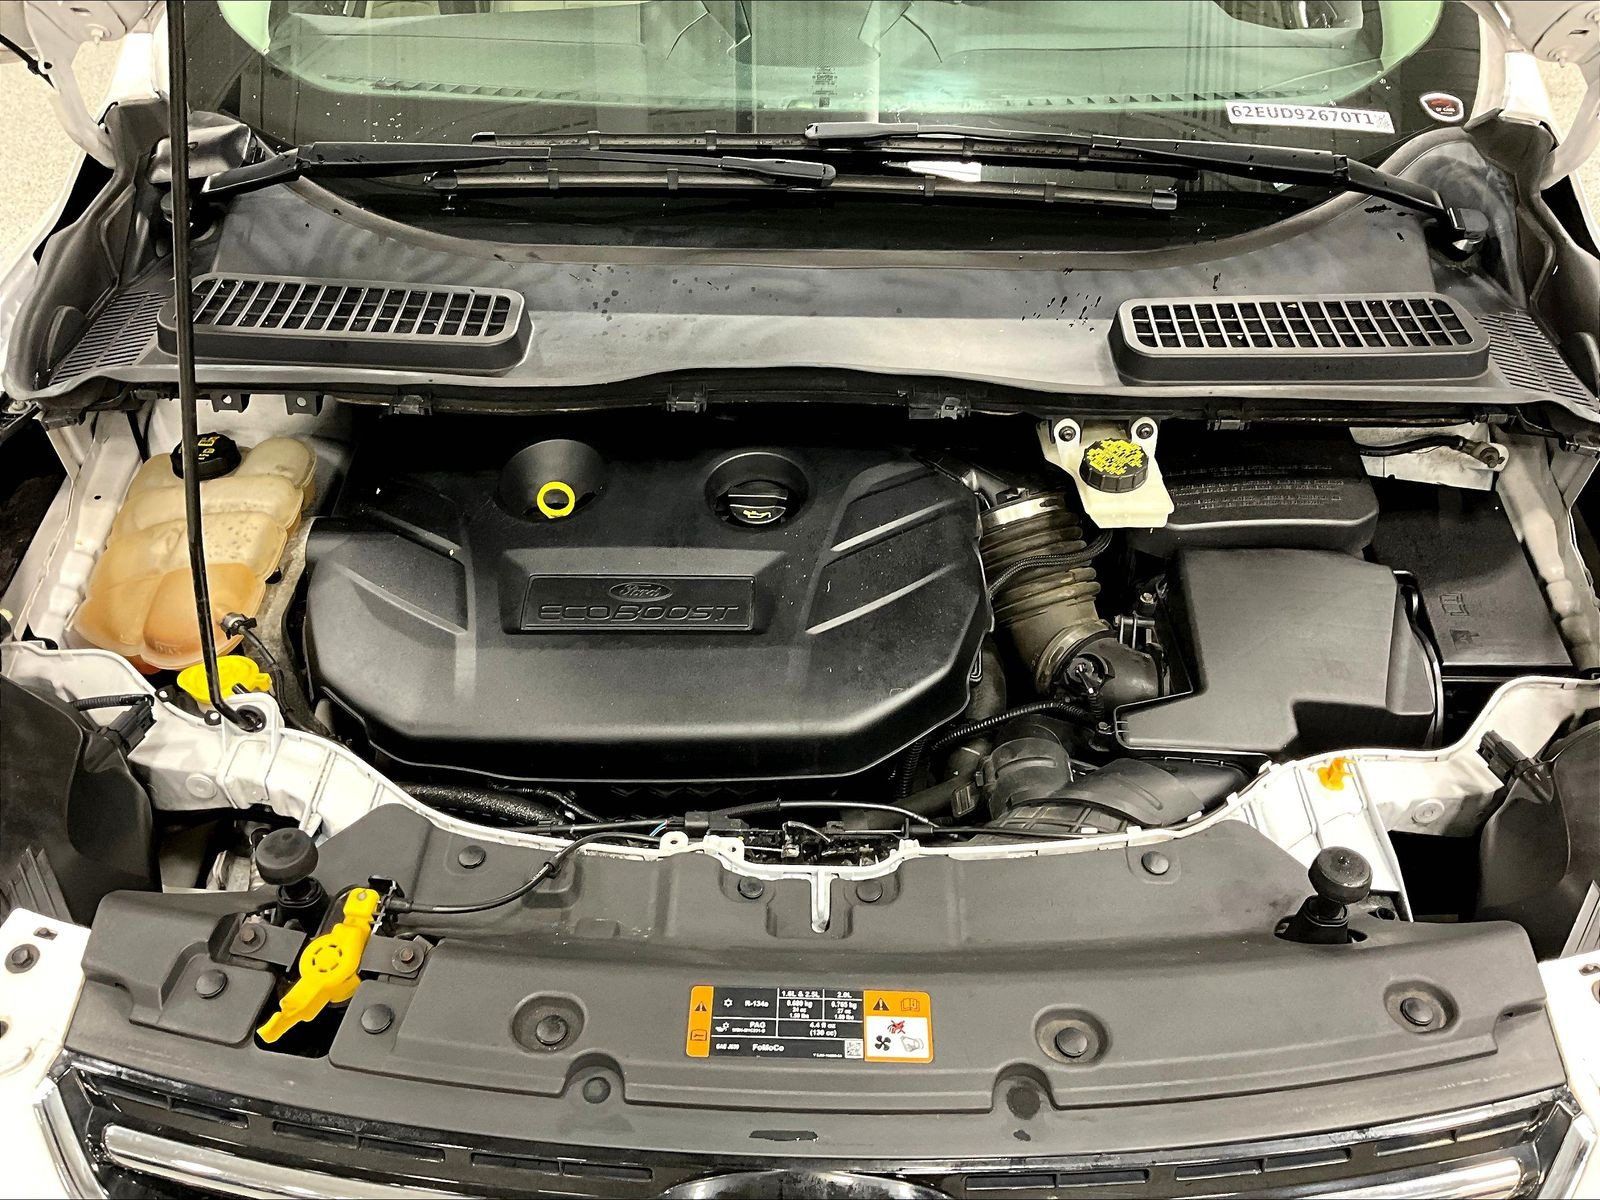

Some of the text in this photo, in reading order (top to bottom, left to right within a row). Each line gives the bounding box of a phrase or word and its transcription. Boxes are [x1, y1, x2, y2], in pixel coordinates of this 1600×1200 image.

[1231, 105, 1374, 125] 62EUD92670T1
[620, 583, 662, 598] Ford
[804, 1000, 813, 1009] kg
[848, 1002, 857, 1010] kg
[809, 1029, 825, 1037] (130
[752, 1044, 785, 1052] FoMoCo
